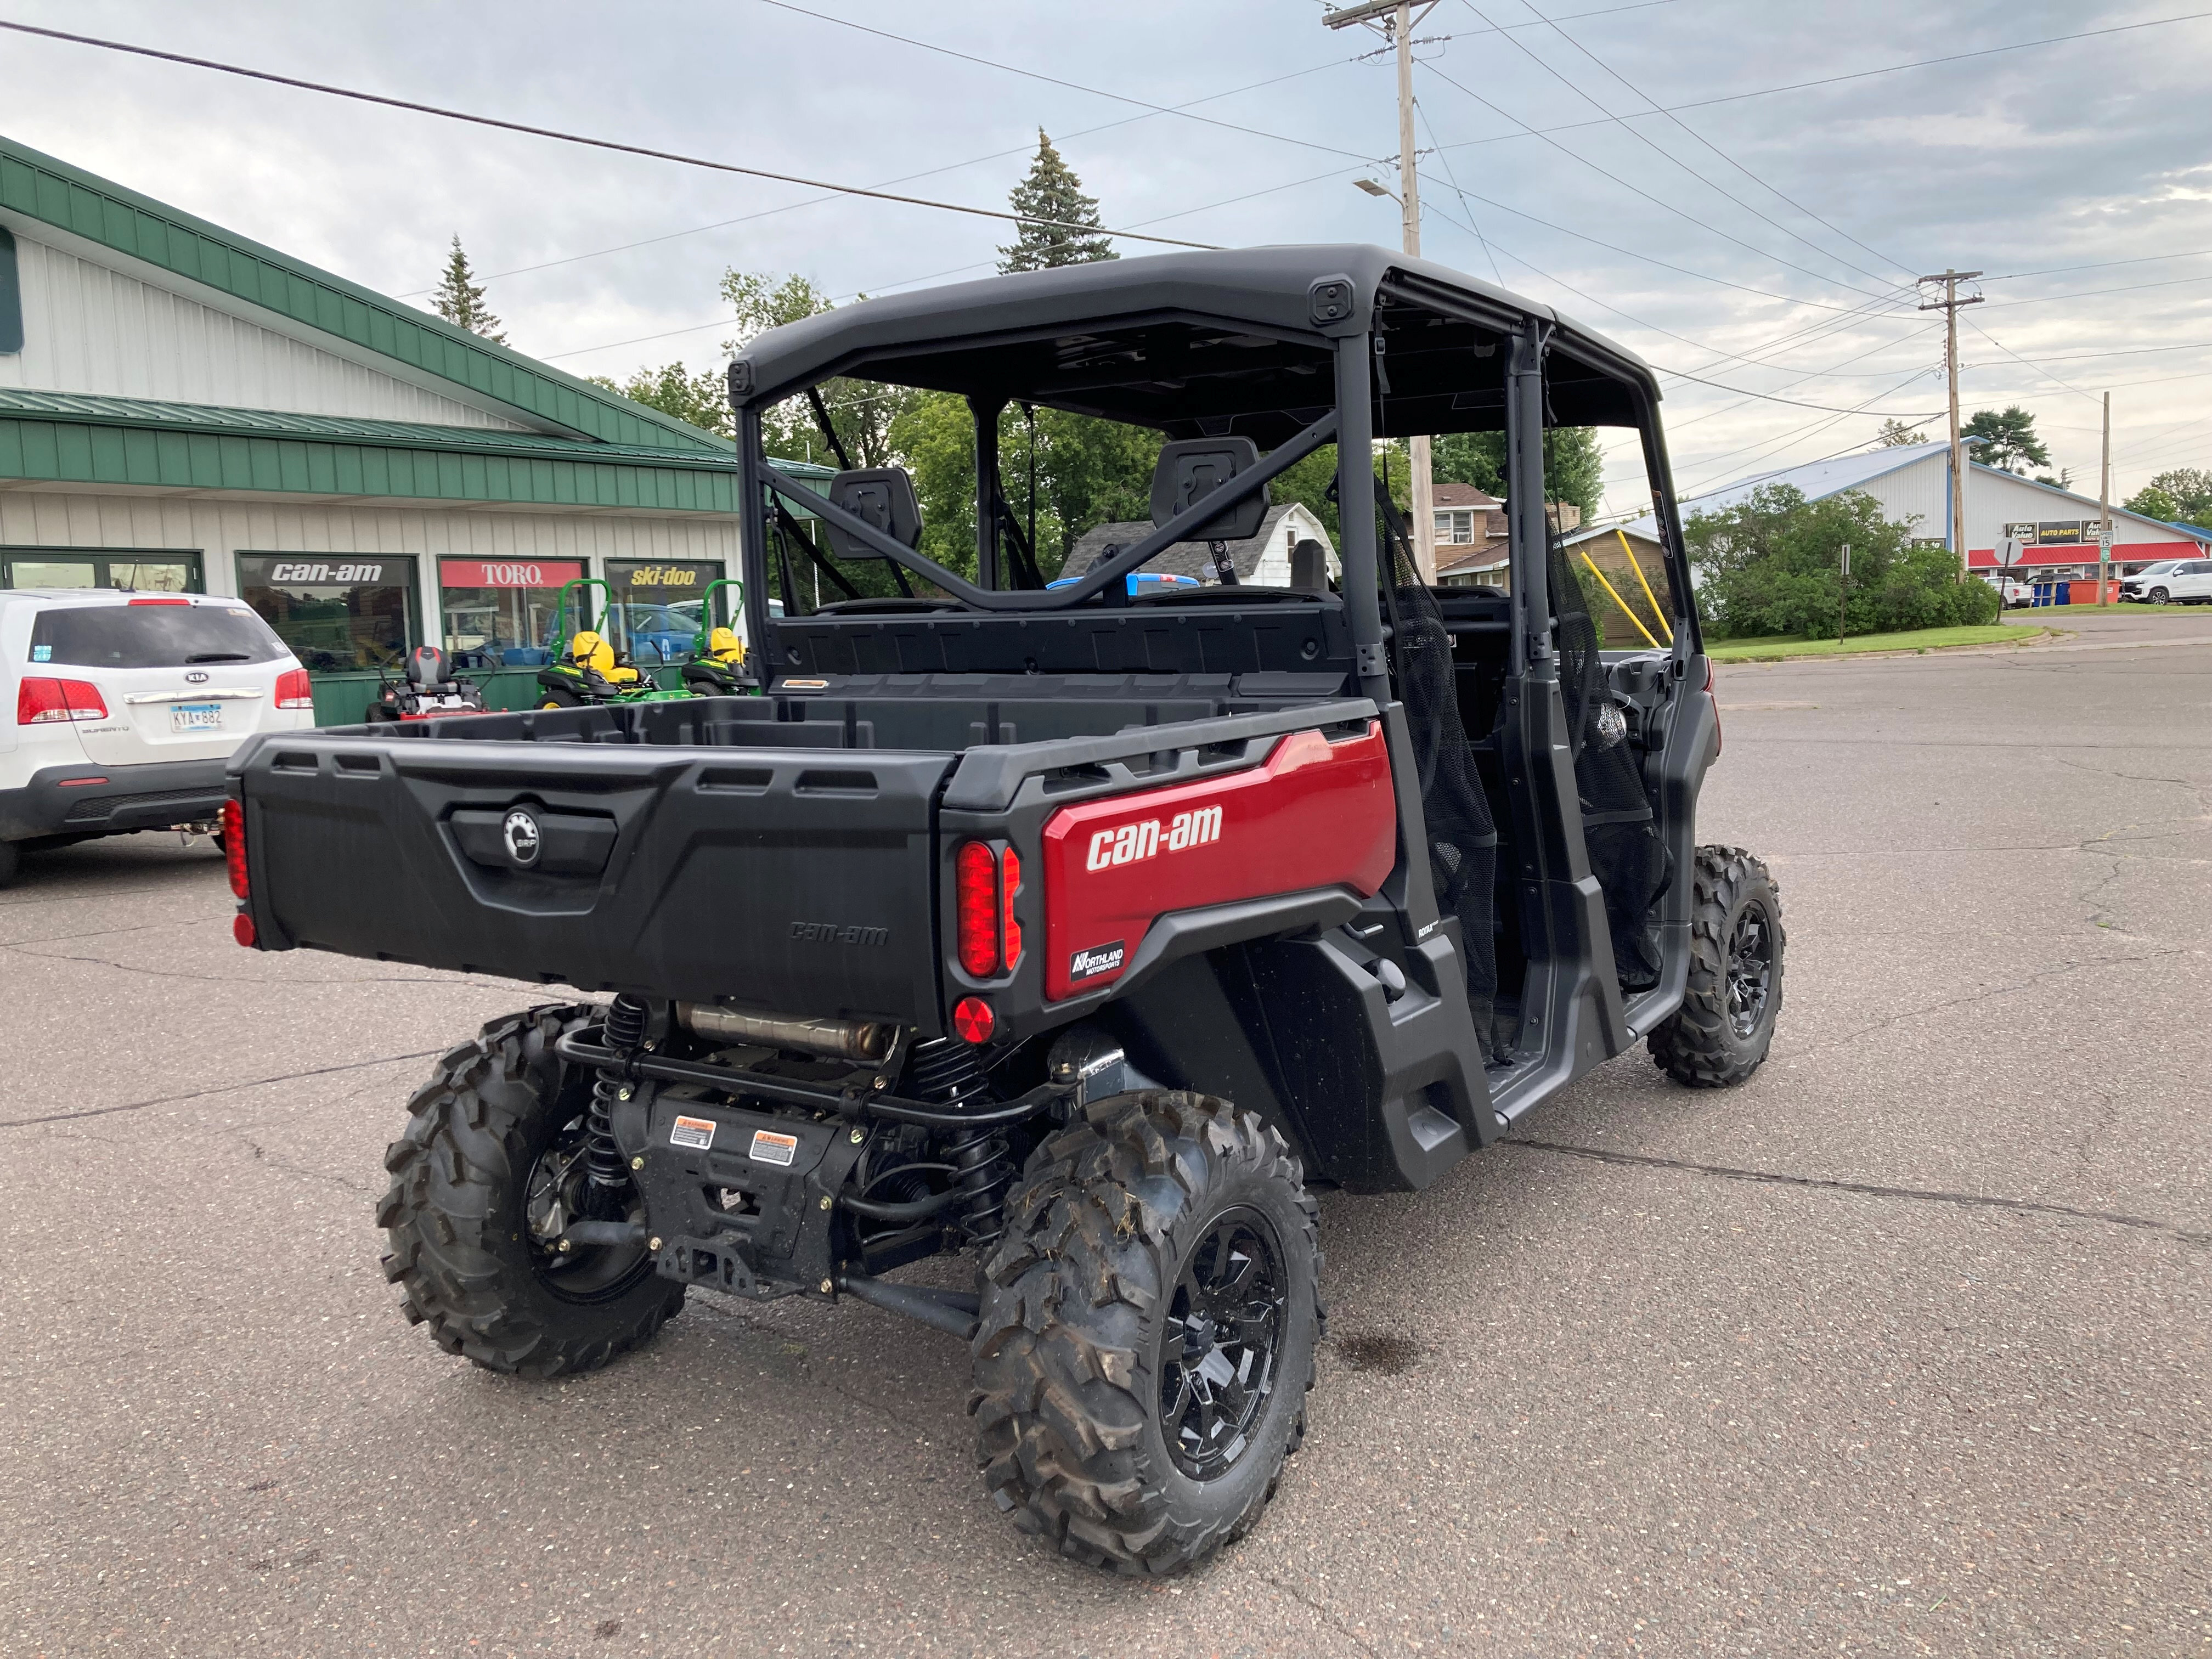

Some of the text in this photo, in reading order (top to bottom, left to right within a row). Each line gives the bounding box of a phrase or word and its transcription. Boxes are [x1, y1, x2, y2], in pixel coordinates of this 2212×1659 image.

[272, 563, 382, 581] can-am
[481, 564, 541, 585] TORO
[631, 566, 696, 585] ski-doo
[173, 710, 222, 725] KYA 882
[516, 839, 537, 848] BRP
[1087, 805, 1223, 871] can-am
[791, 922, 888, 946] can-am
[1418, 923, 1433, 938] ROTAX
[1072, 949, 1123, 973] NORTHLAND
[1086, 960, 1120, 975] MOTORSPORTS
